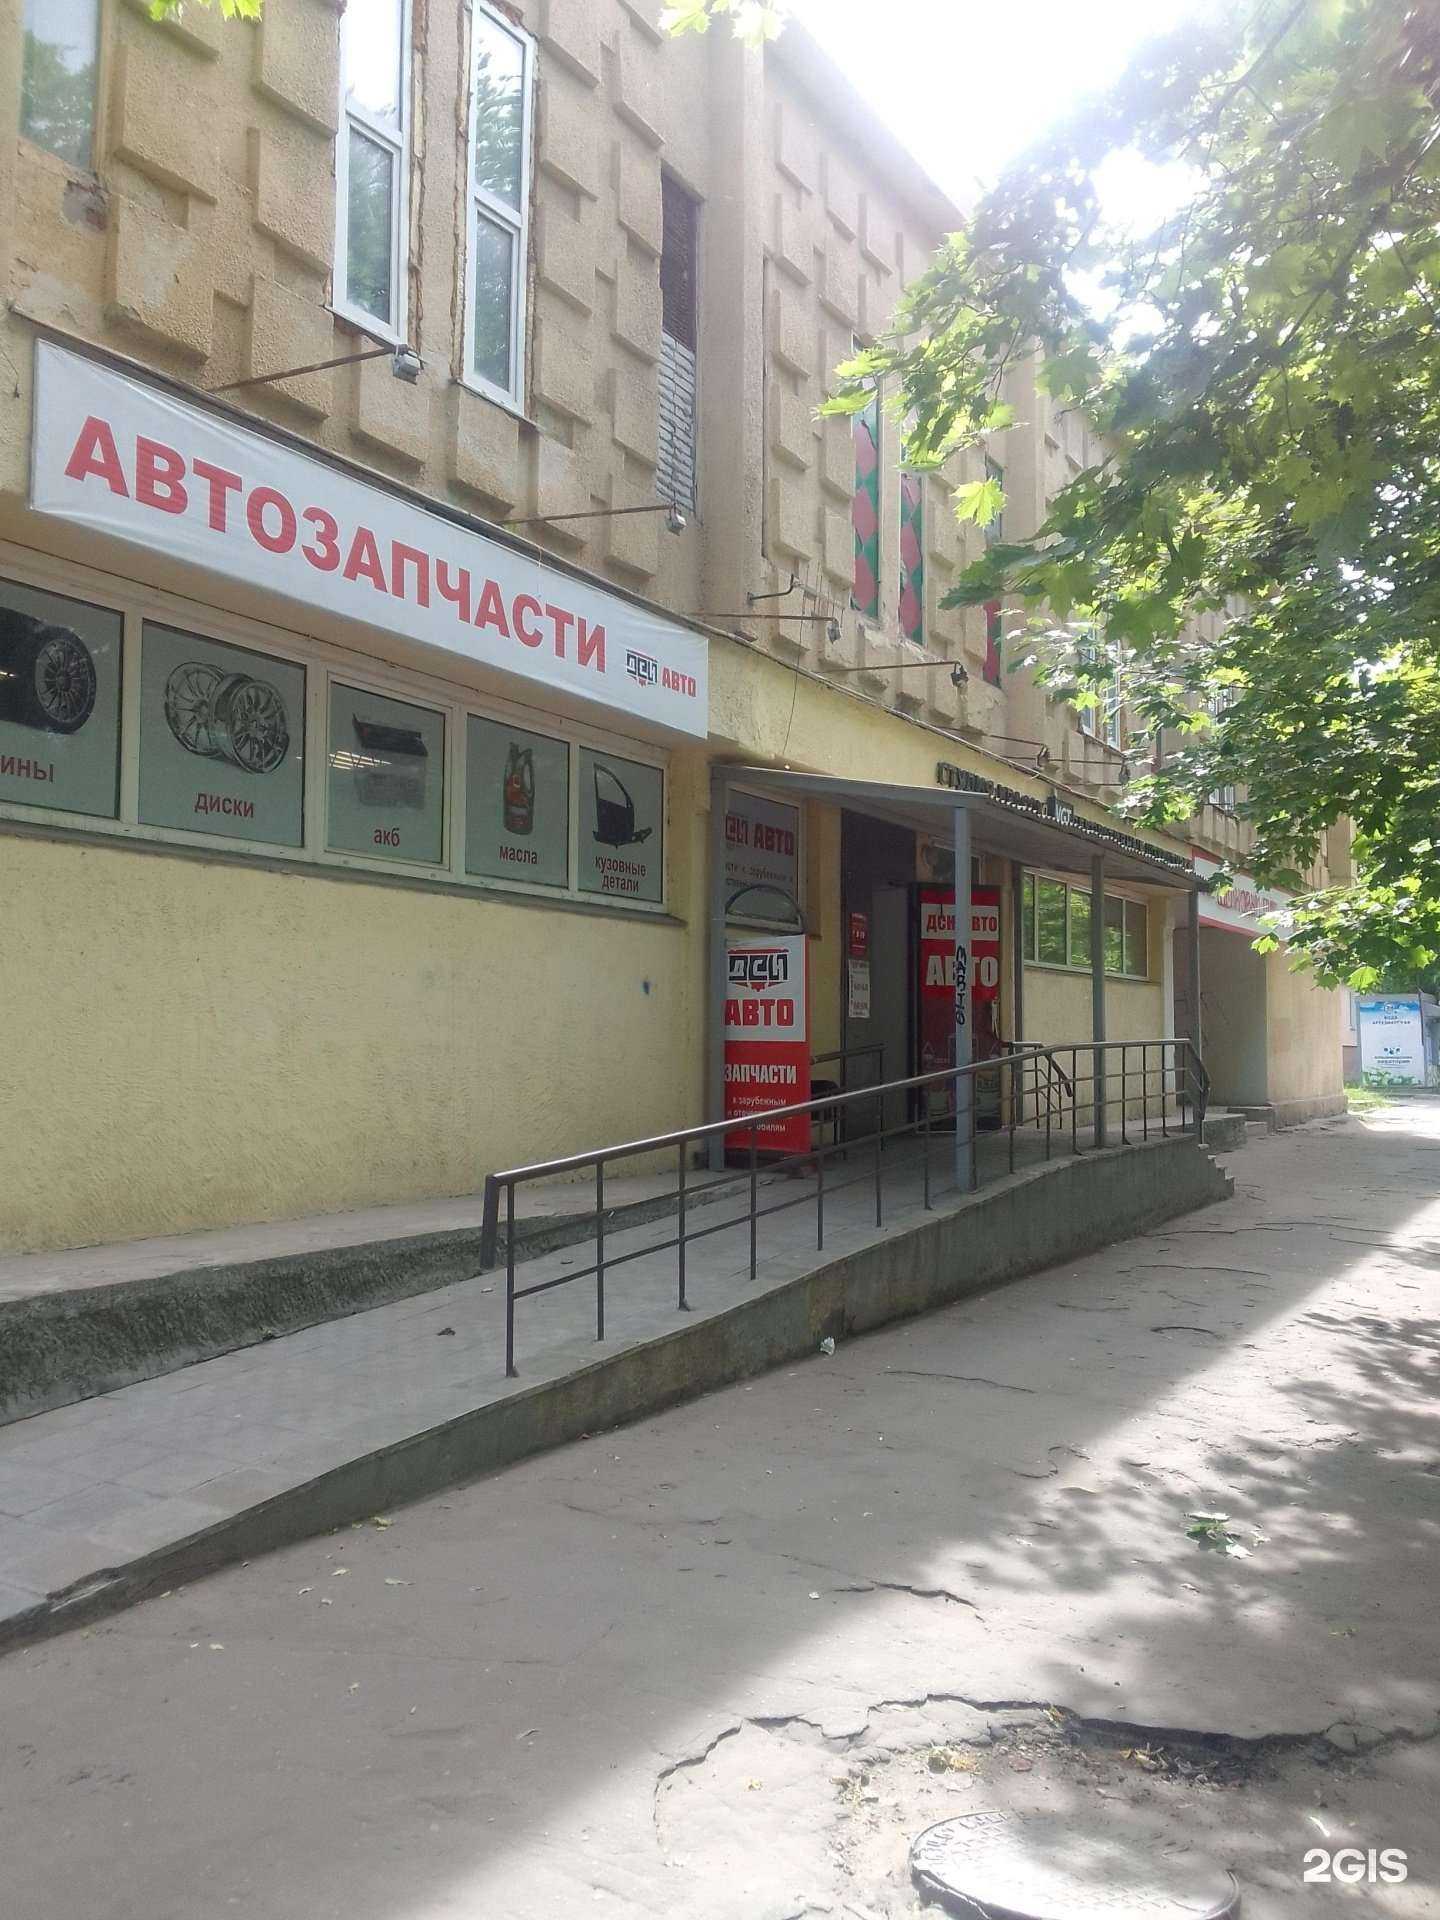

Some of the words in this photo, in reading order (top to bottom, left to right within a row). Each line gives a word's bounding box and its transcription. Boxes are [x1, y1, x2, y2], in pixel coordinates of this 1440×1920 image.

[64, 415, 606, 673] АВТОЗАПЧАСТИ
[661, 667, 696, 697] АВТО
[753, 822, 794, 857] АВТО
[595, 856, 647, 877] кузовные
[602, 874, 639, 893] детали
[724, 998, 794, 1027] АВТО
[724, 1063, 797, 1084] ЗАПЧАСТИ
